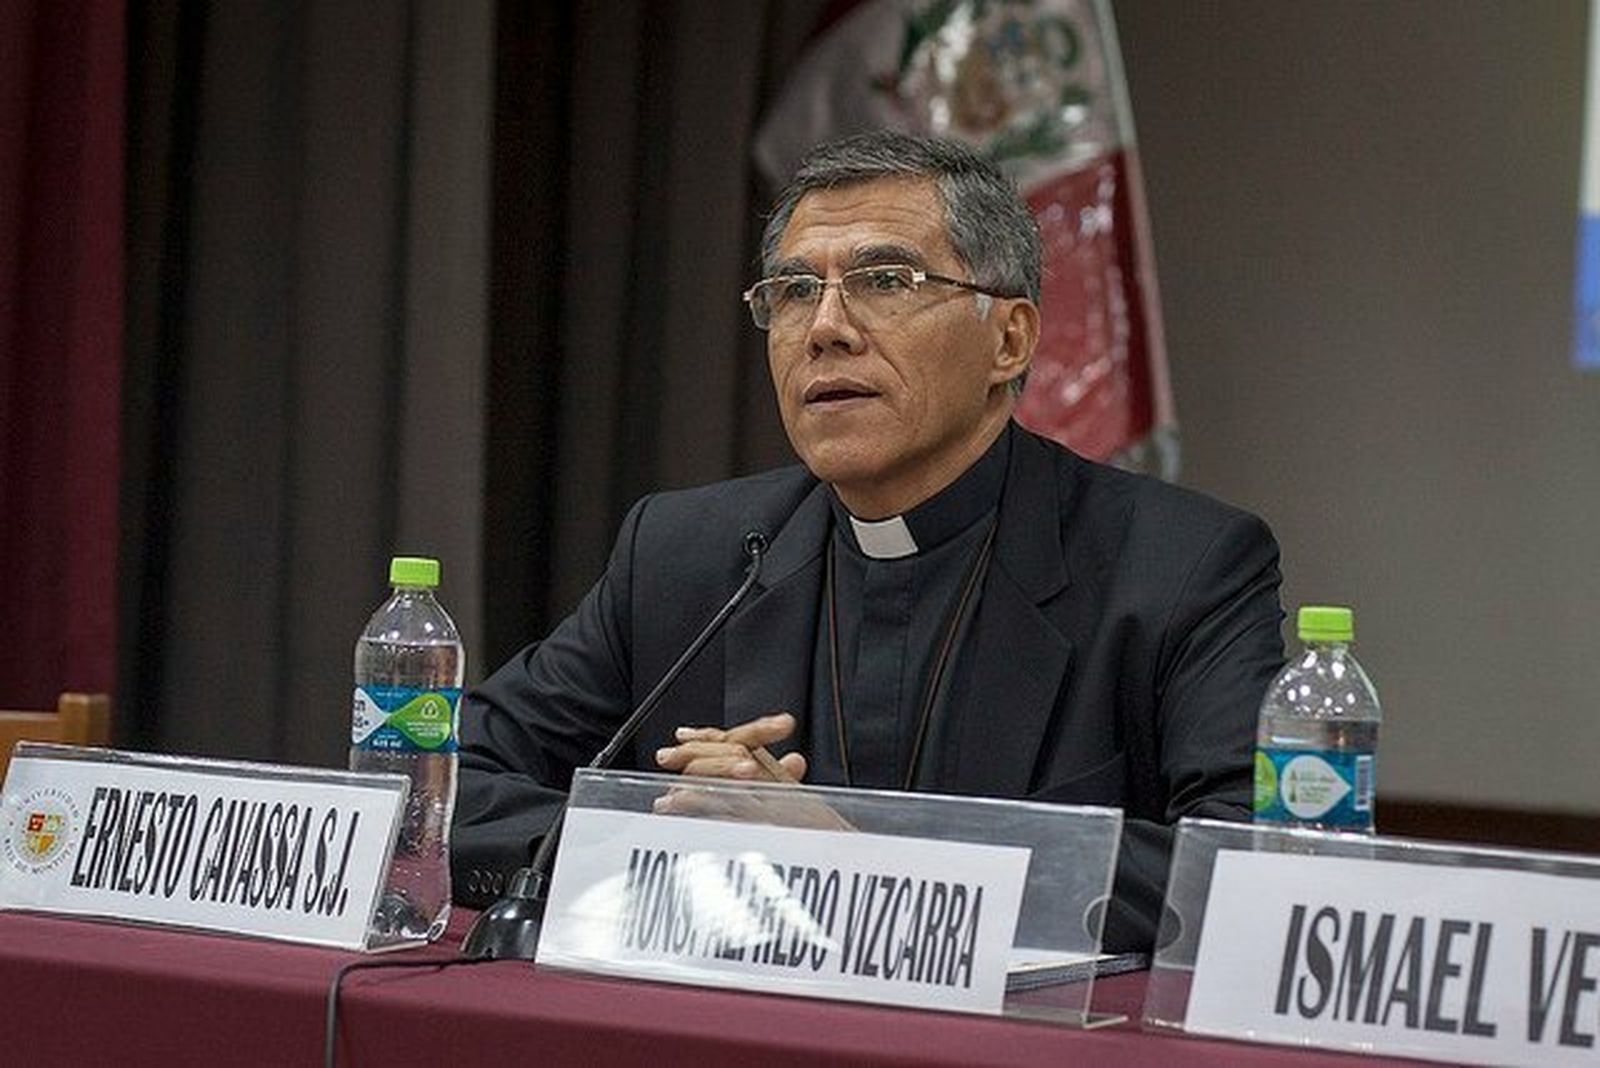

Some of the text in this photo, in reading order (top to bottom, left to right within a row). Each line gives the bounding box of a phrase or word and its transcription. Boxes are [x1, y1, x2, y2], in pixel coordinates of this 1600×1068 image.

[70, 787, 360, 916] ERNESTO CAVASSA S.J.
[839, 872, 984, 988] VIZCARRA
[1274, 904, 1600, 1048] ISMAEL VE
